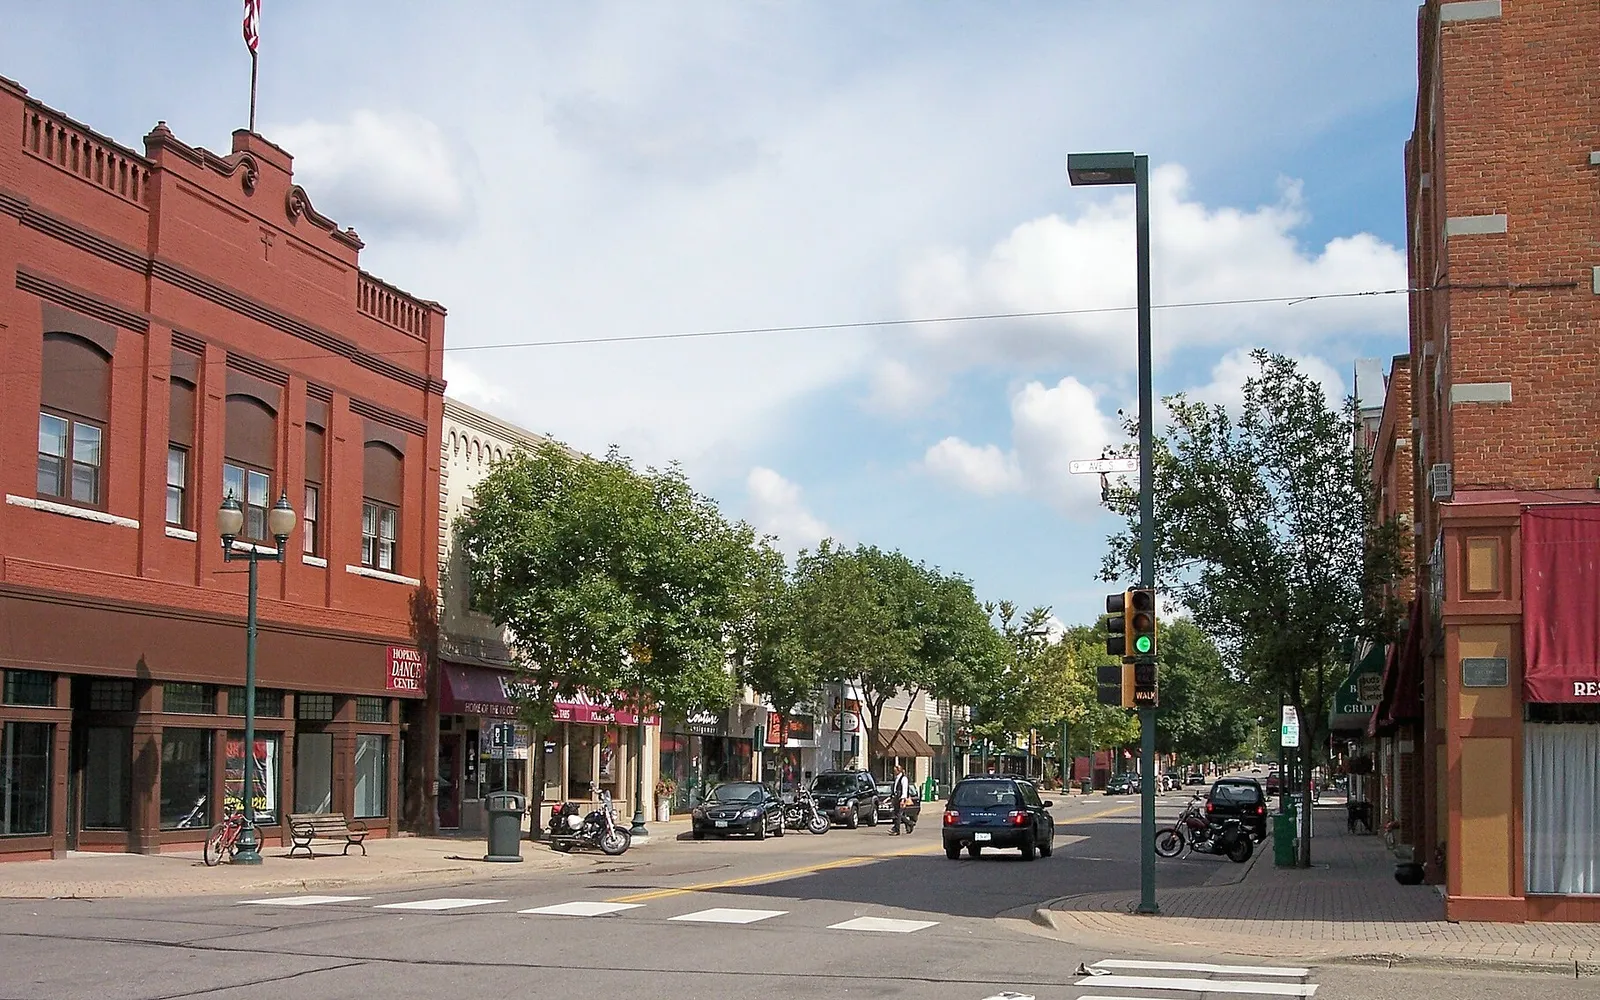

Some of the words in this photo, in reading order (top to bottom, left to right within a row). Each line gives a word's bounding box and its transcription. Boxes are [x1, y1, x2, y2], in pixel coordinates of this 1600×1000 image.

[1089, 462, 1104, 470] AVE
[1109, 461, 1114, 470] S
[392, 648, 420, 661] HOPKINS
[391, 660, 421, 678] DANCE
[393, 678, 419, 690] CENTER
[1135, 690, 1156, 700] WALK
[465, 702, 481, 713] HOME
[482, 703, 488, 714] OF
